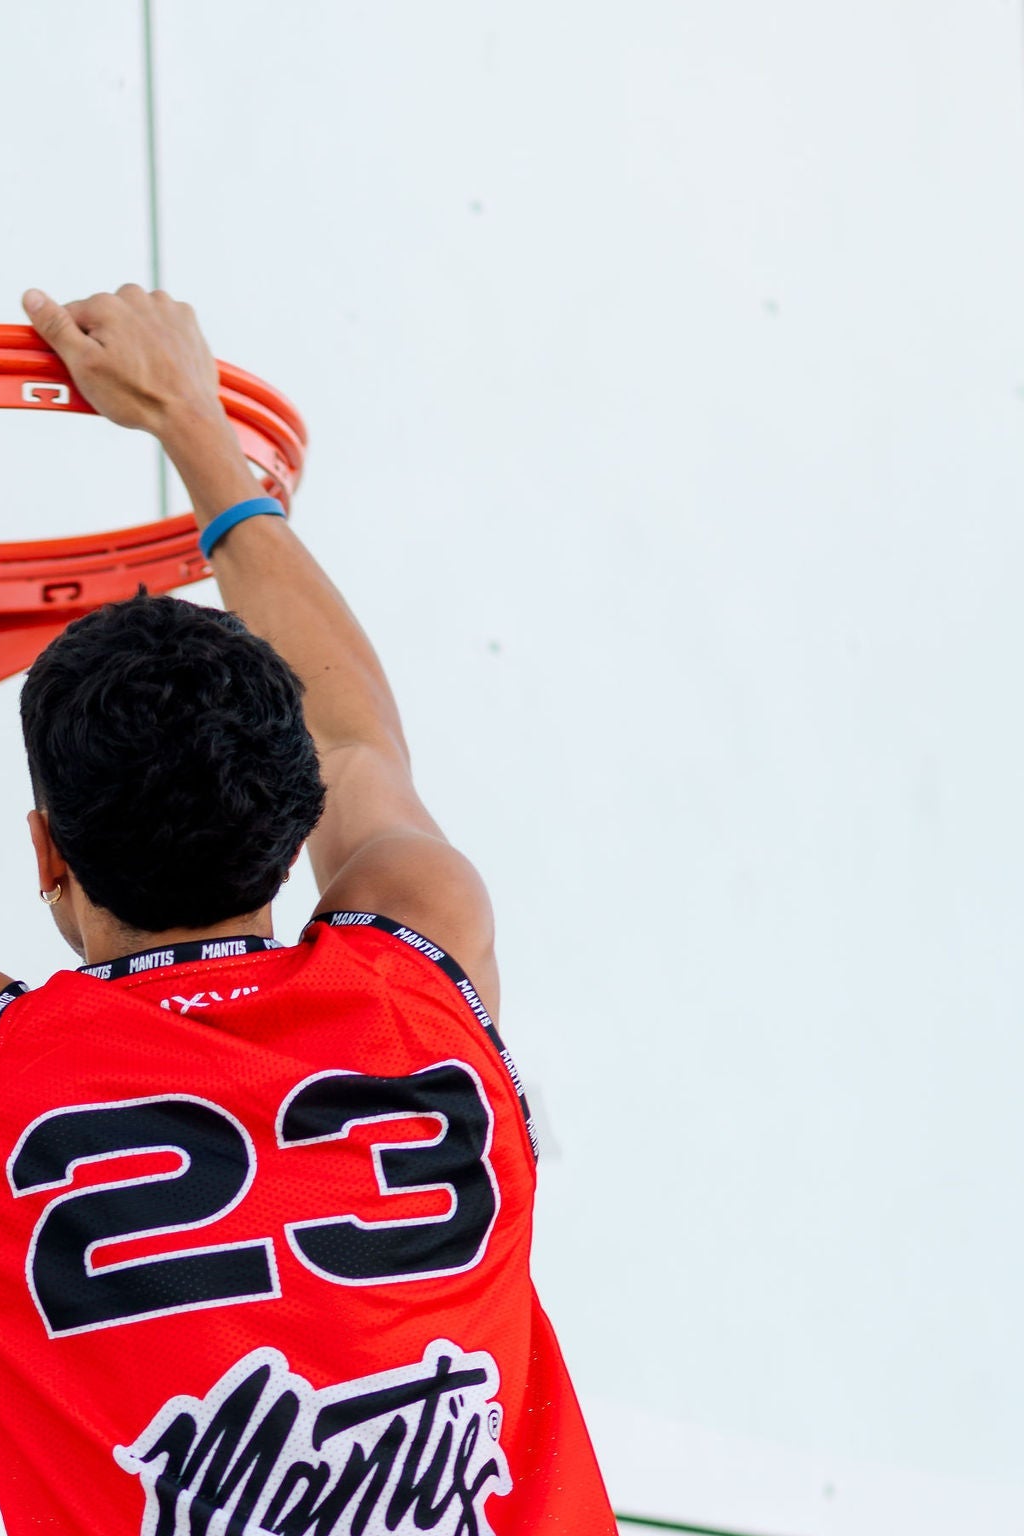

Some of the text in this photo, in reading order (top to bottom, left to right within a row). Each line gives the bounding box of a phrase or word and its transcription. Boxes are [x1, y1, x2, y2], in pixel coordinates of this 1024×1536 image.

[129, 950, 174, 975] MANTIS
[201, 940, 247, 960] MANTIS
[329, 912, 377, 927] MANTIS
[392, 927, 447, 961] MANTIS
[457, 979, 492, 1027] MANTIS
[6, 1058, 502, 1340] 23
